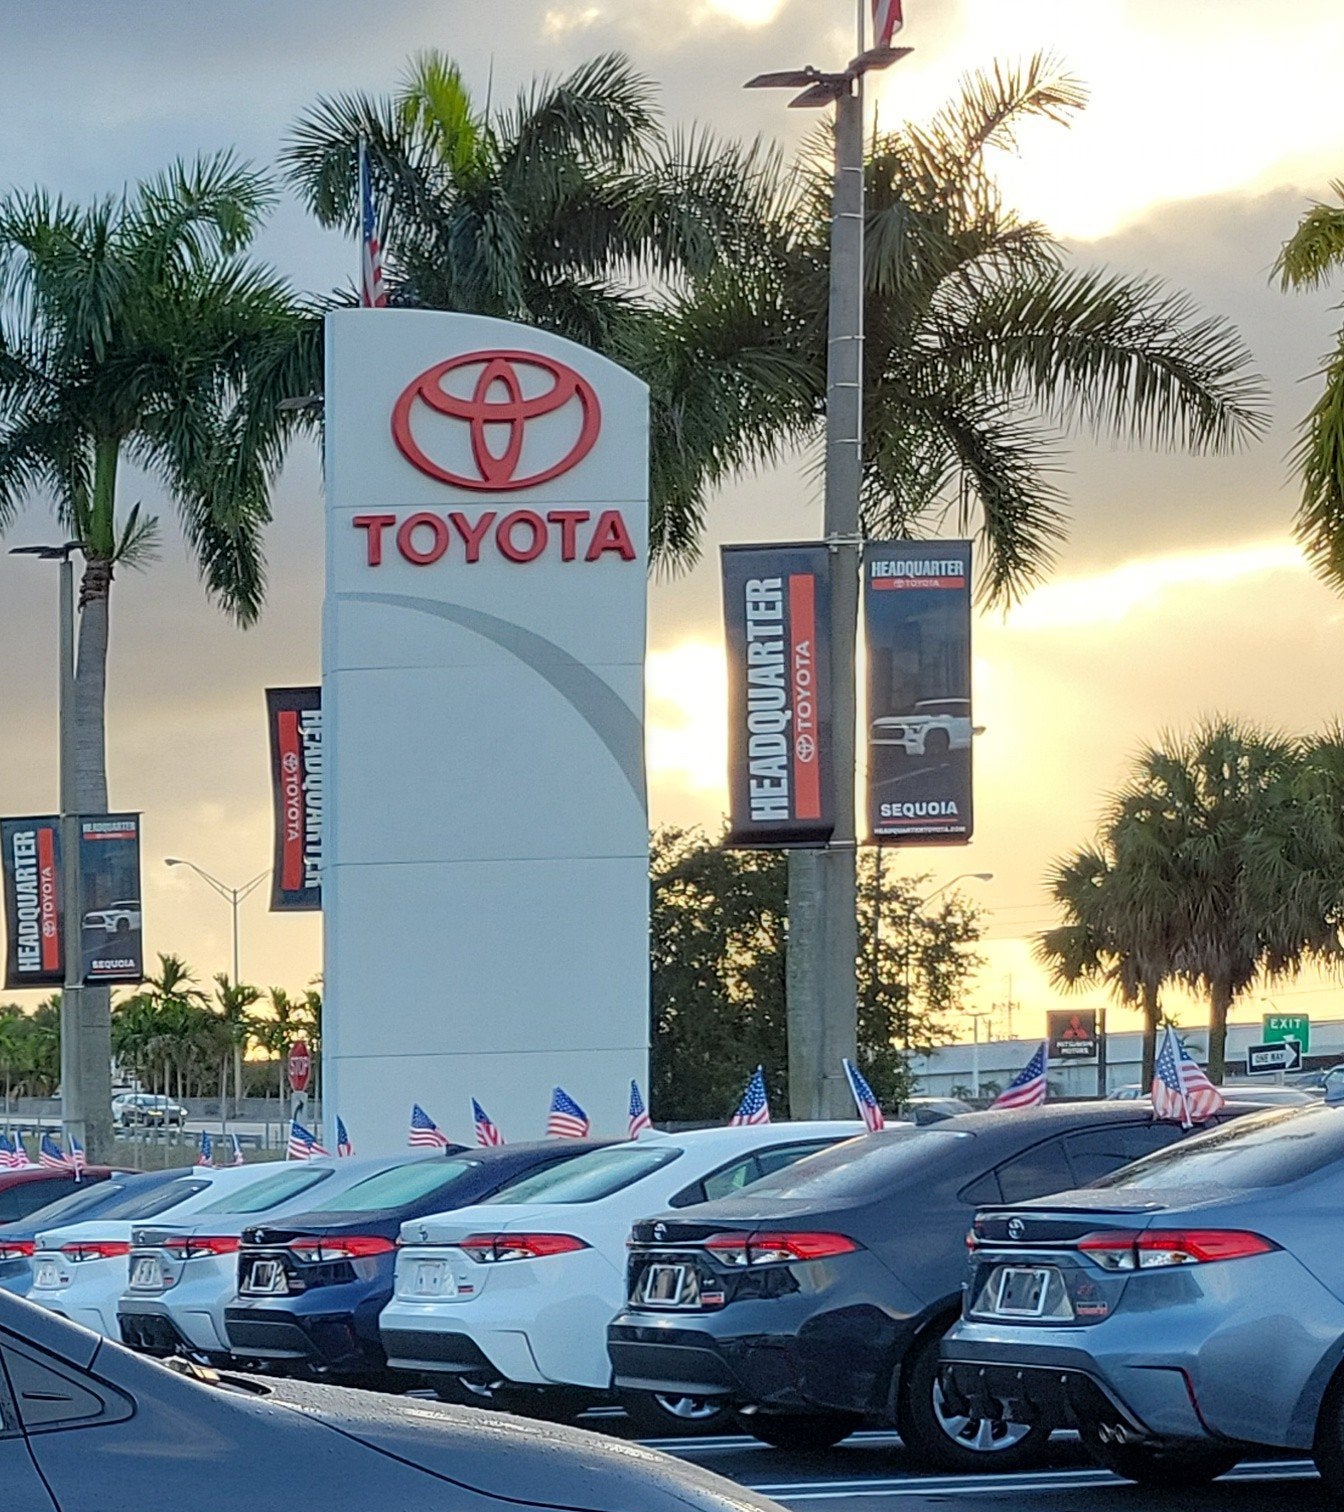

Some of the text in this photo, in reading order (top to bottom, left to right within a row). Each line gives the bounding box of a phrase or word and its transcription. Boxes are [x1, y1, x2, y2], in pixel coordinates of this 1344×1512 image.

[353, 509, 636, 567] TOYOTA
[871, 560, 964, 578] HEADQUARTER
[906, 579, 940, 588] TOYOTA
[745, 577, 790, 823] HEADQUARTER
[796, 640, 811, 732] TOYOTA
[286, 774, 301, 842] TOYOTA
[880, 801, 958, 818] SEQUOIA
[14, 831, 41, 972] HEADQUARTER
[43, 867, 53, 922] TOYOTA
[92, 959, 135, 969] SEQUOIA
[1270, 1018, 1301, 1029] EXIT
